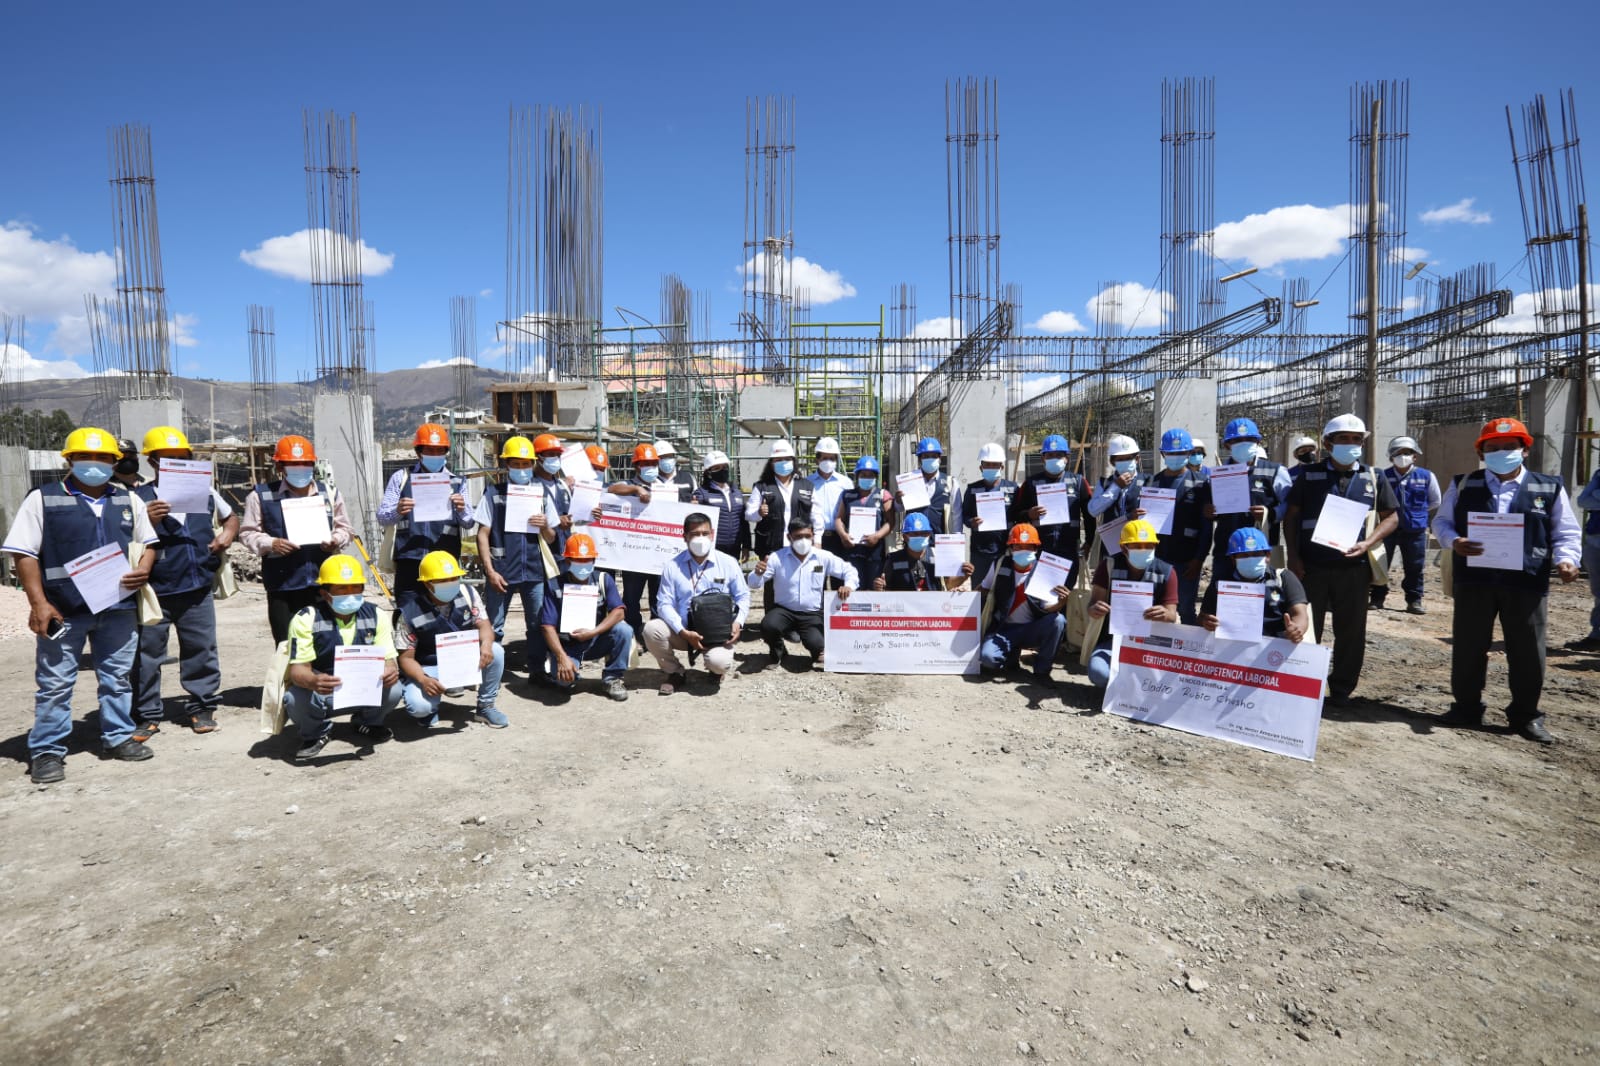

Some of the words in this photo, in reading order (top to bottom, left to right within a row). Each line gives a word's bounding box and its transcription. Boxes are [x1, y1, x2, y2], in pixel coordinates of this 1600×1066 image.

[600, 519, 630, 530] CERTIFICADO
[637, 523, 670, 533] COMPETENCIA
[1142, 654, 1182, 669] CERTIFICADO
[1183, 662, 1193, 671] DE
[1194, 664, 1243, 680] COMPETENCIA
[1245, 672, 1280, 687] LABORAL
[1182, 686, 1210, 701] Rubio
